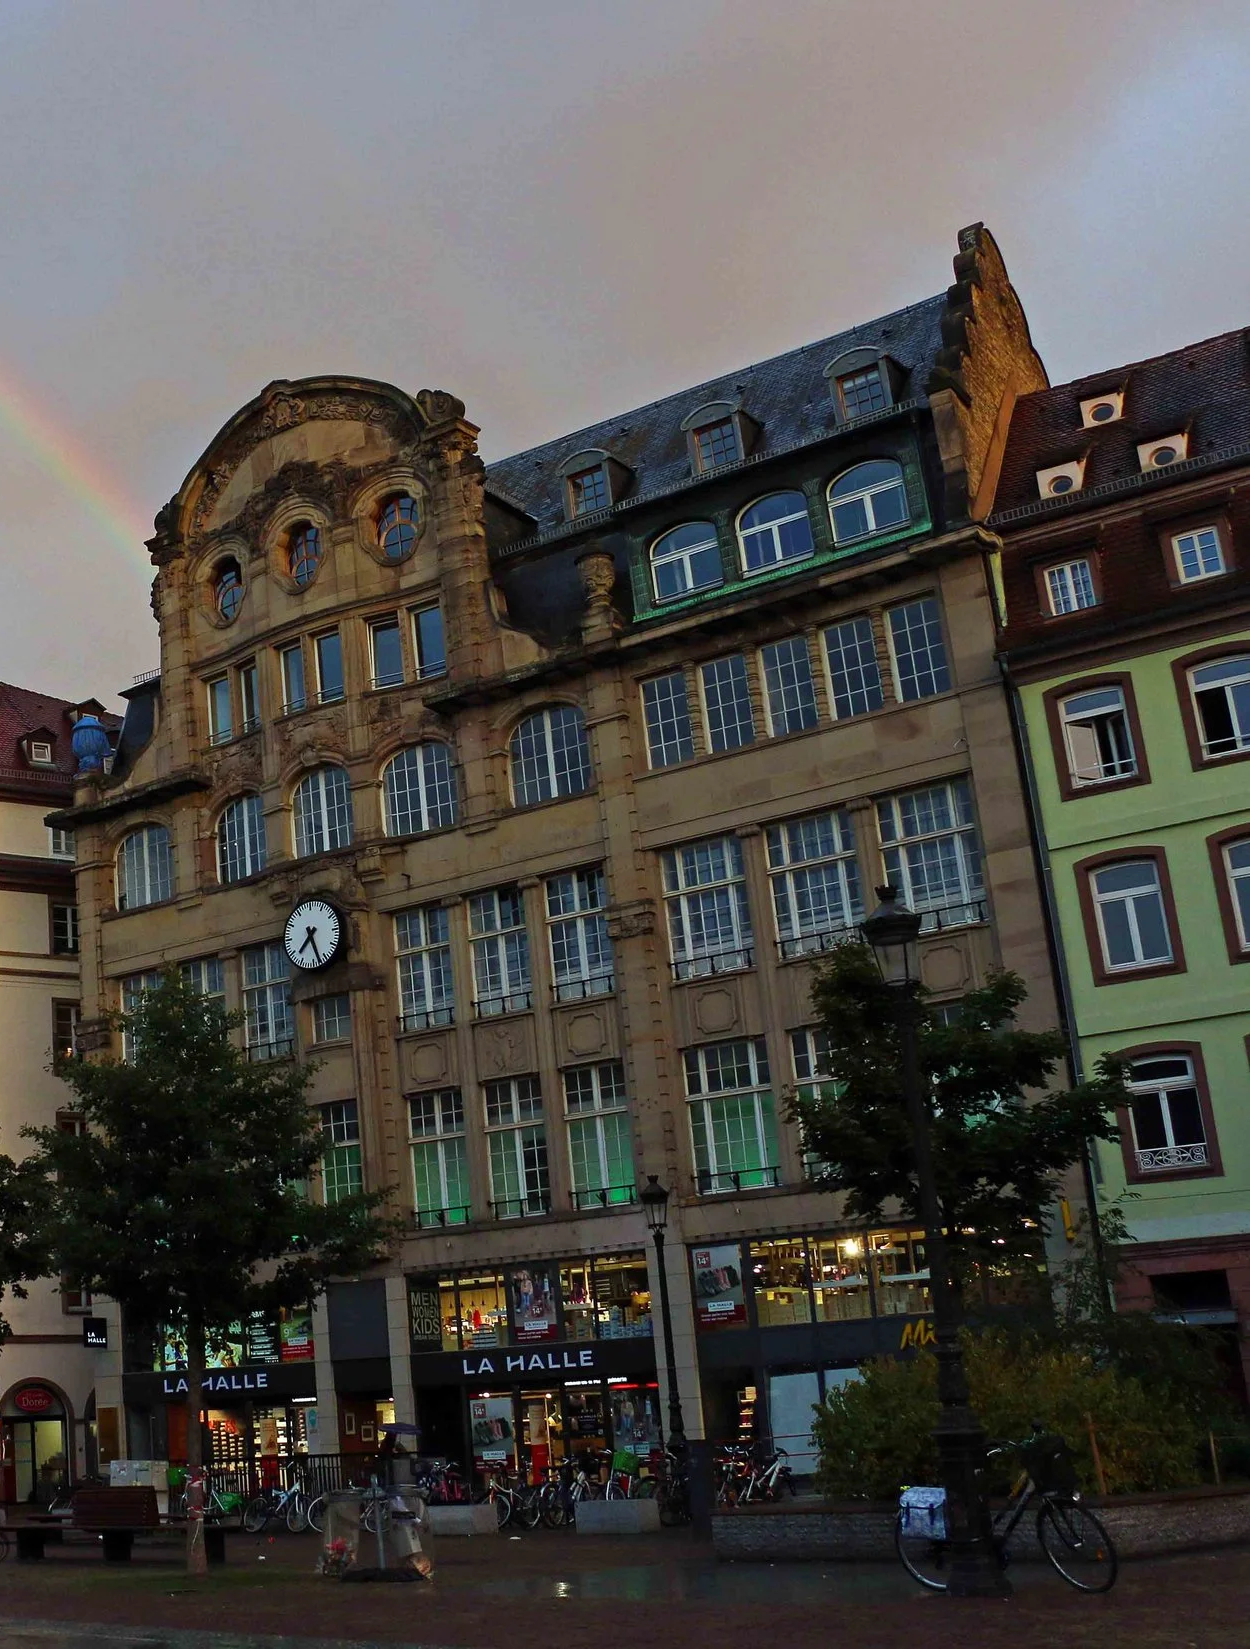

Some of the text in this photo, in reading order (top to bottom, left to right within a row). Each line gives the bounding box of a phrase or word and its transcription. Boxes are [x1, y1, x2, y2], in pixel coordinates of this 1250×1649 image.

[410, 1291, 439, 1306] MEN
[411, 1305, 440, 1319] WOMEN
[412, 1318, 441, 1335] KIDS
[462, 1350, 594, 1375] LA HALLE
[163, 1372, 268, 1393] LA HALLE
